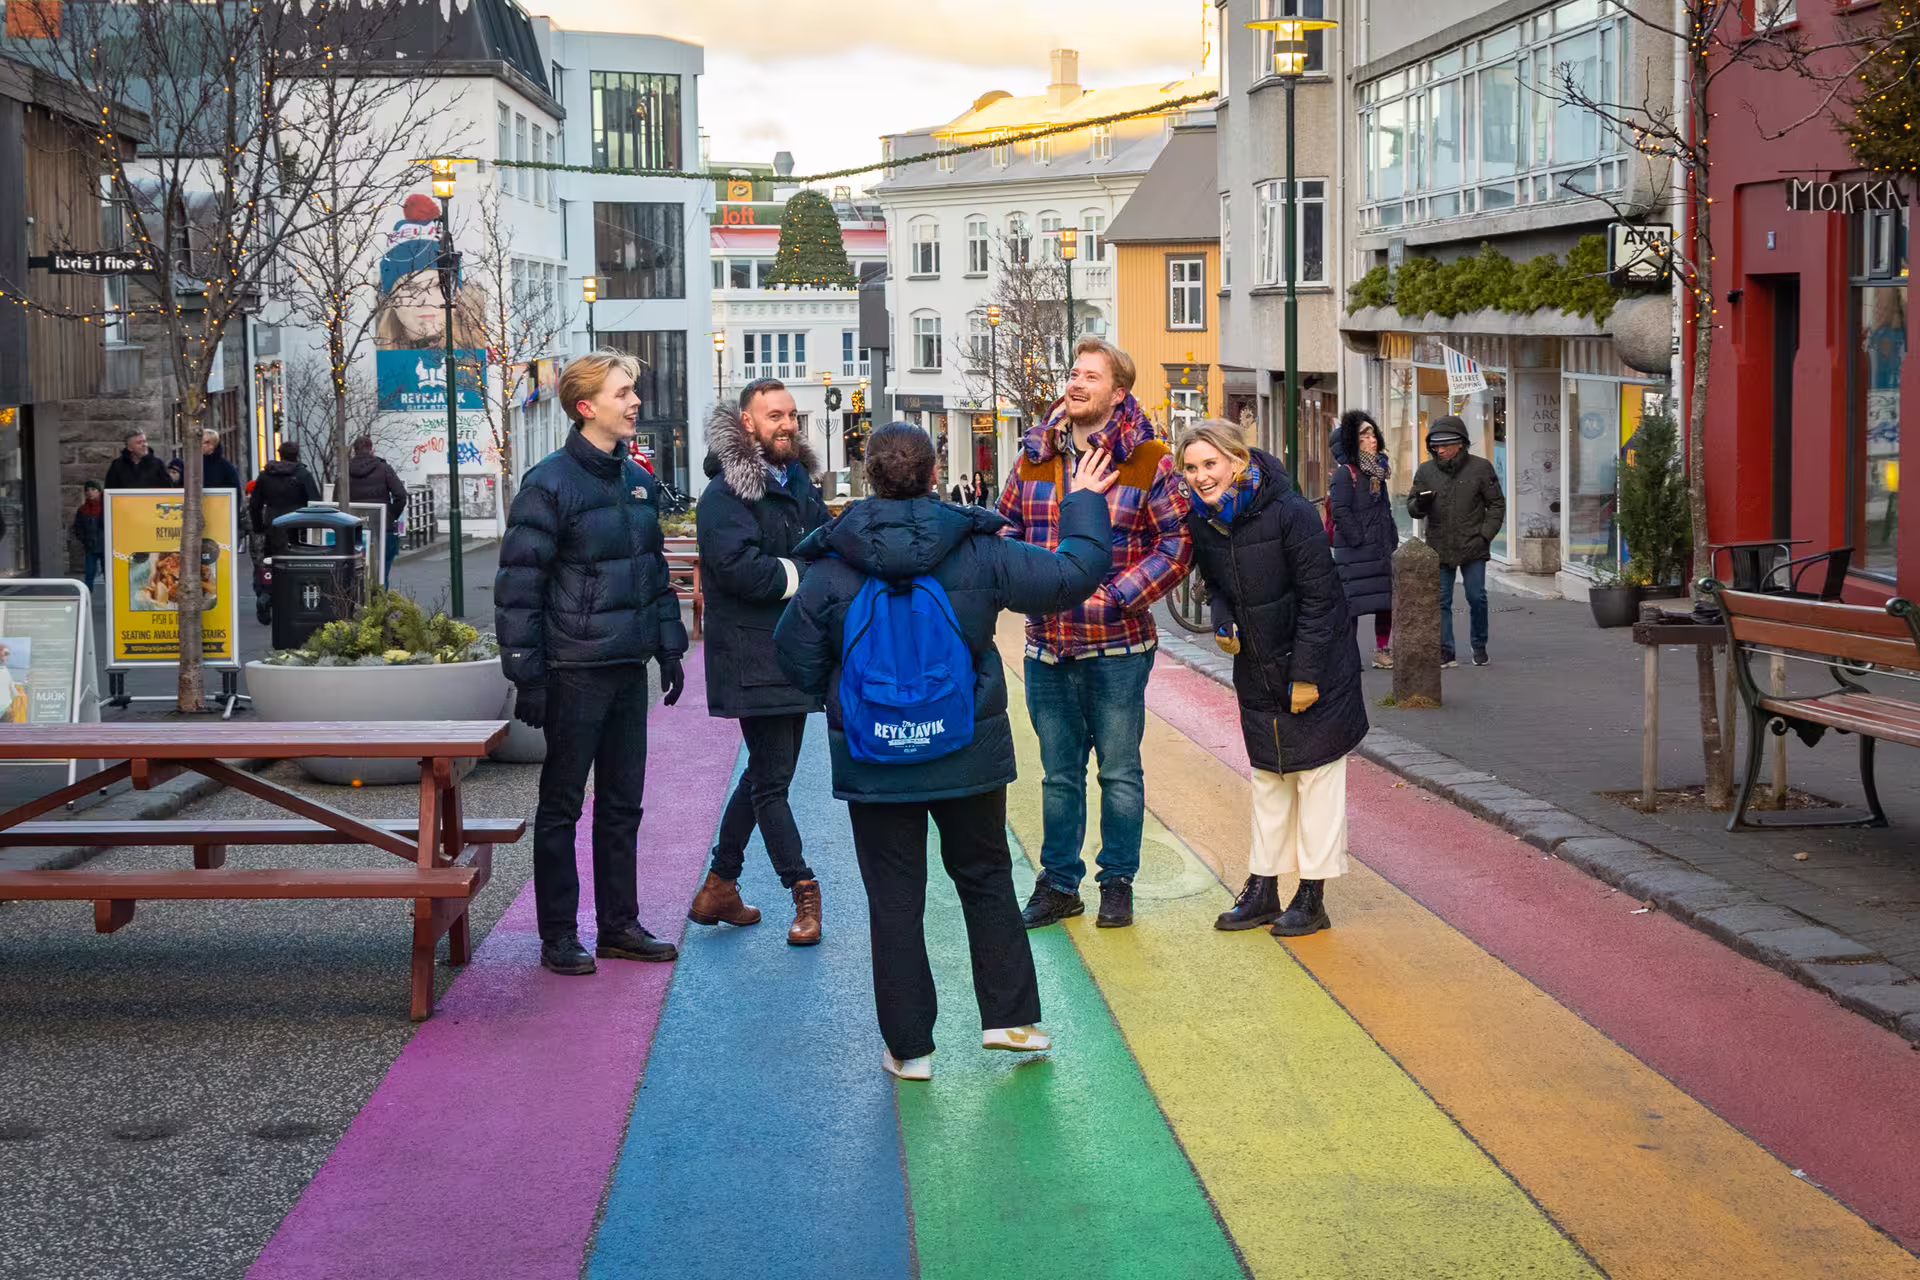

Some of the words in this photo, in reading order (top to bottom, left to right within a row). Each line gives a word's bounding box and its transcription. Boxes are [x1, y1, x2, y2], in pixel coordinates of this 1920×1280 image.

[1792, 179, 1902, 214] MOKKA
[722, 204, 755, 225] loft
[1623, 231, 1665, 246] ATM
[1464, 374, 1480, 382] FREE
[1453, 381, 1482, 391] SHOPPING
[401, 392, 466, 404] REYKJAK
[152, 614, 167, 624] FISH
[121, 630, 151, 640] SEATING
[153, 630, 180, 639] AVAILA
[202, 629, 226, 639] STAIRS
[36, 690, 66, 702] MJÚK
